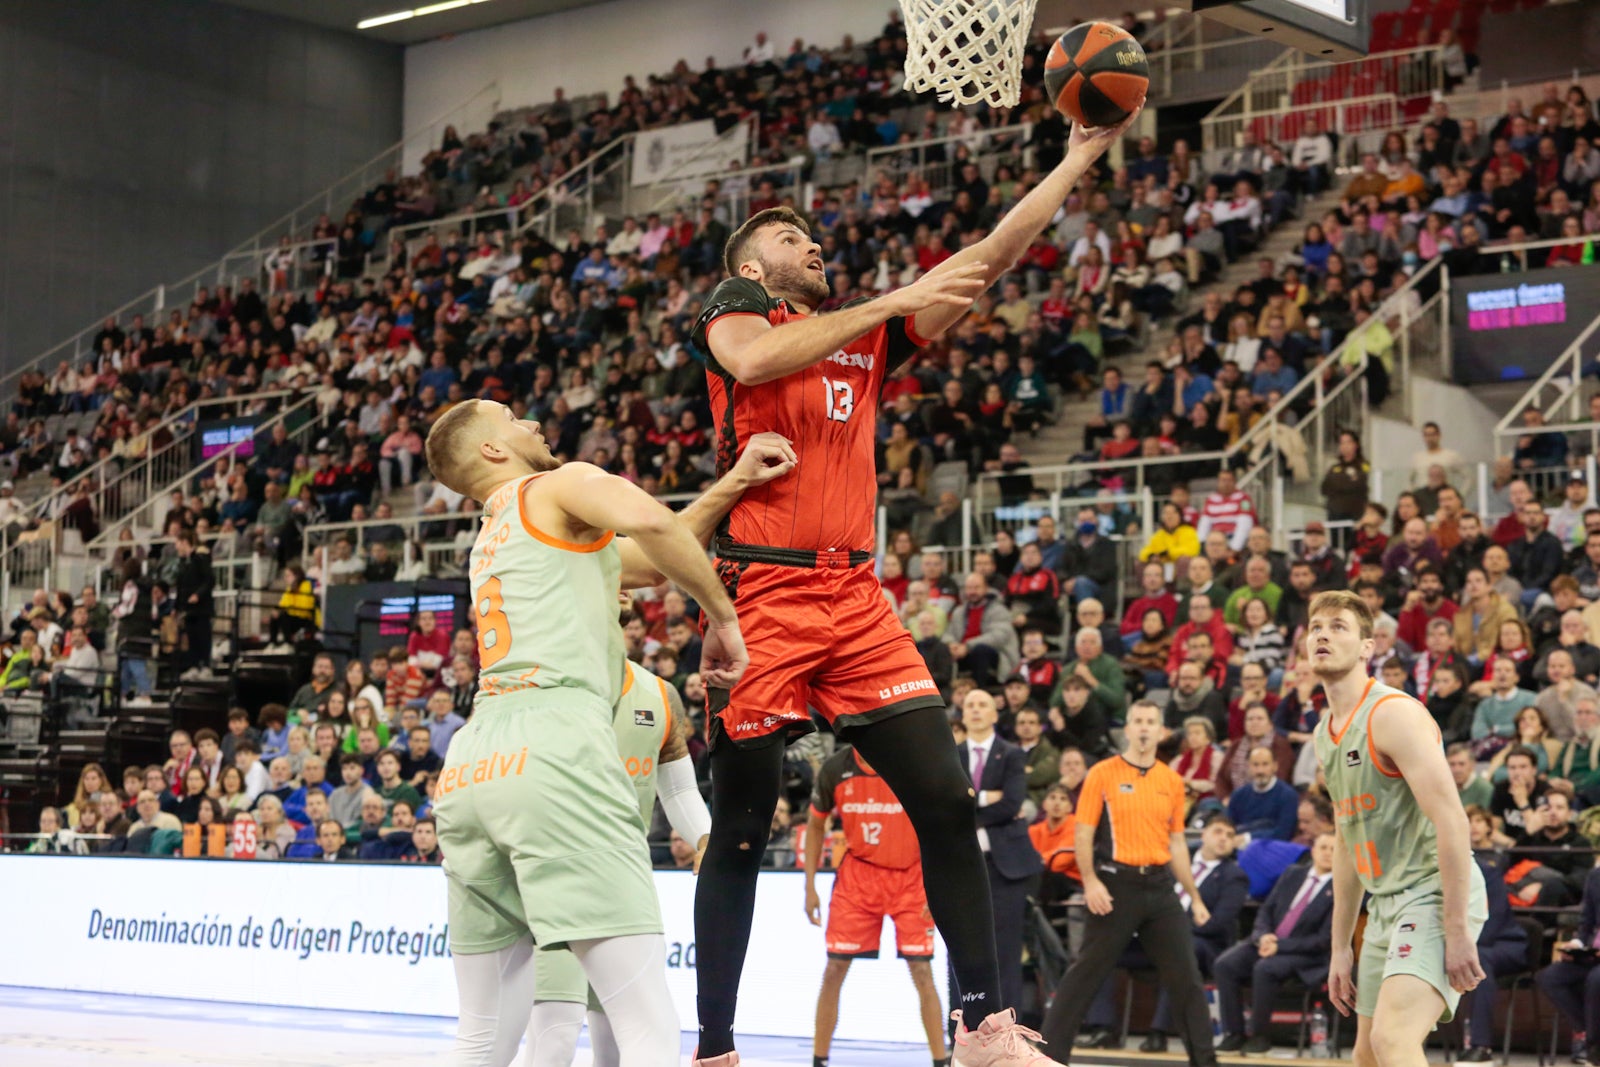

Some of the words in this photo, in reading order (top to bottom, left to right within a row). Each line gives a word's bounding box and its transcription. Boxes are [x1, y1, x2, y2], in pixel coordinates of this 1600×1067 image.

[822, 375, 854, 423] 13
[476, 575, 512, 670] 8
[234, 823, 257, 854] 55
[861, 821, 882, 845] 12
[1354, 840, 1384, 880] 41
[88, 908, 233, 947] Denominación
[238, 915, 264, 949] de
[270, 916, 342, 960] Origen
[347, 920, 453, 965] Protegid
